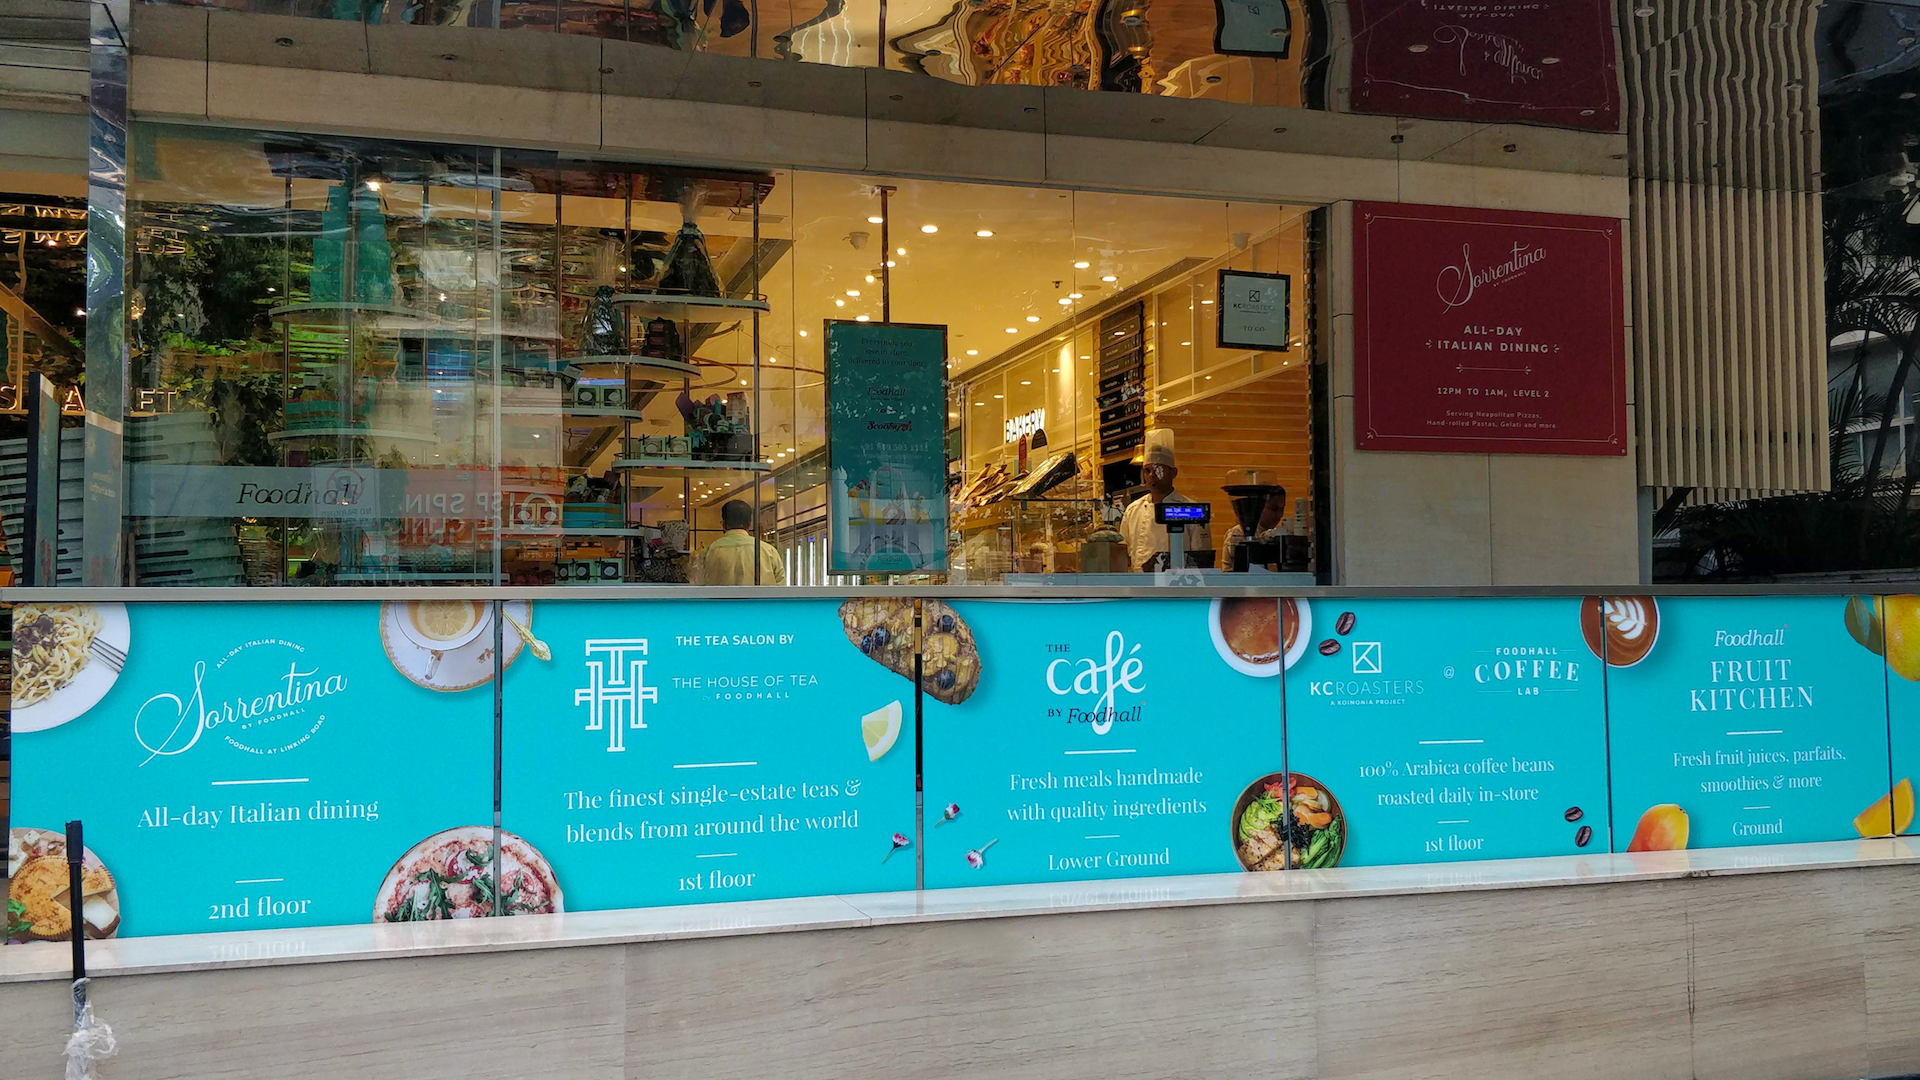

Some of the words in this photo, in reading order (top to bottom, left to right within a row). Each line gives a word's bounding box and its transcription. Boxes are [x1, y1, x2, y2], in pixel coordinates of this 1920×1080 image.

[1436, 240, 1547, 315] Sorrentina
[1463, 325, 1523, 337] ALL-DAY
[1437, 339, 1493, 351] ITALIAN
[1499, 342, 1549, 354] DINING
[1437, 386, 1462, 395] 12PM
[1466, 387, 1480, 396] TO
[1484, 388, 1508, 398] 1AM,
[1513, 389, 1541, 398] LEVEL
[1543, 390, 1550, 398] 2
[1426, 419, 1470, 427] Hand-rolled
[1445, 409, 1474, 419] Serving
[1475, 411, 1515, 419] Neapolitan
[235, 482, 362, 505] Foodhall
[675, 635, 701, 647] THE
[704, 635, 730, 646] TEA
[732, 634, 775, 646] SALON
[779, 634, 794, 645] BY
[1045, 643, 1072, 653] THE
[1714, 628, 1784, 647] Foodhall
[216, 645, 243, 669] ALL-DAY
[244, 638, 276, 648] ITALIAN
[278, 639, 305, 653] DINING
[1495, 646, 1559, 656] FOODHALL
[672, 676, 702, 689] THE
[707, 675, 759, 689] HOUSE
[763, 674, 784, 687] OF
[789, 674, 819, 687] TEA
[1443, 666, 1455, 679] @
[1474, 659, 1580, 684] COFFEE
[1711, 658, 1792, 683] FRUIT
[1046, 630, 1147, 736] café
[1516, 686, 1540, 696] LAB
[715, 692, 789, 701] FOODHALL
[1375, 698, 1405, 706] PROJECT
[1690, 685, 1813, 712] KITCHEN
[133, 659, 348, 768] Sorrentina
[241, 722, 253, 730] BY
[256, 705, 305, 726] FOODHALL
[1047, 707, 1063, 719] BY
[1066, 706, 1143, 725] Foodhall
[224, 735, 264, 755] FOODHALL
[267, 747, 278, 755] AT
[280, 733, 311, 753] LINKING
[310, 714, 326, 734] ROAD
[1359, 761, 1399, 778] 100%
[1402, 758, 1460, 776] Arabica
[1463, 757, 1509, 775] coffee
[1511, 756, 1555, 773] beans
[1673, 750, 1712, 767] Fresh
[1715, 749, 1744, 766] fruit
[1010, 771, 1058, 791] Fresh
[1063, 769, 1113, 789] meals
[1116, 766, 1203, 787] handmade
[1700, 775, 1770, 793] smoothies
[1772, 774, 1785, 790] &
[1788, 776, 1822, 789] more
[563, 790, 603, 810] The
[609, 788, 664, 808] finest
[670, 783, 797, 807] single-estate
[802, 782, 839, 799] teas
[844, 778, 861, 797] &
[1377, 787, 1435, 806] roasted
[1438, 785, 1475, 807] daily
[1479, 786, 1539, 802] in-store
[137, 805, 223, 829] All-day
[230, 802, 301, 824] Italian
[307, 799, 379, 822] dining
[1007, 802, 1045, 821] with
[1050, 800, 1108, 824] quality
[1113, 797, 1207, 820] ingredients
[567, 821, 634, 843] blends
[640, 820, 688, 840] from
[694, 814, 764, 837] around
[770, 813, 800, 832] the
[805, 809, 859, 830] world
[1732, 818, 1783, 836] Ground
[1425, 837, 1444, 853] 1st
[1448, 834, 1484, 852] floor
[1049, 854, 1103, 871] Lower
[1106, 847, 1170, 867] Ground
[679, 873, 703, 891] 1st
[709, 869, 756, 889] floor
[208, 897, 250, 920] 2nd
[257, 895, 312, 917] floor
